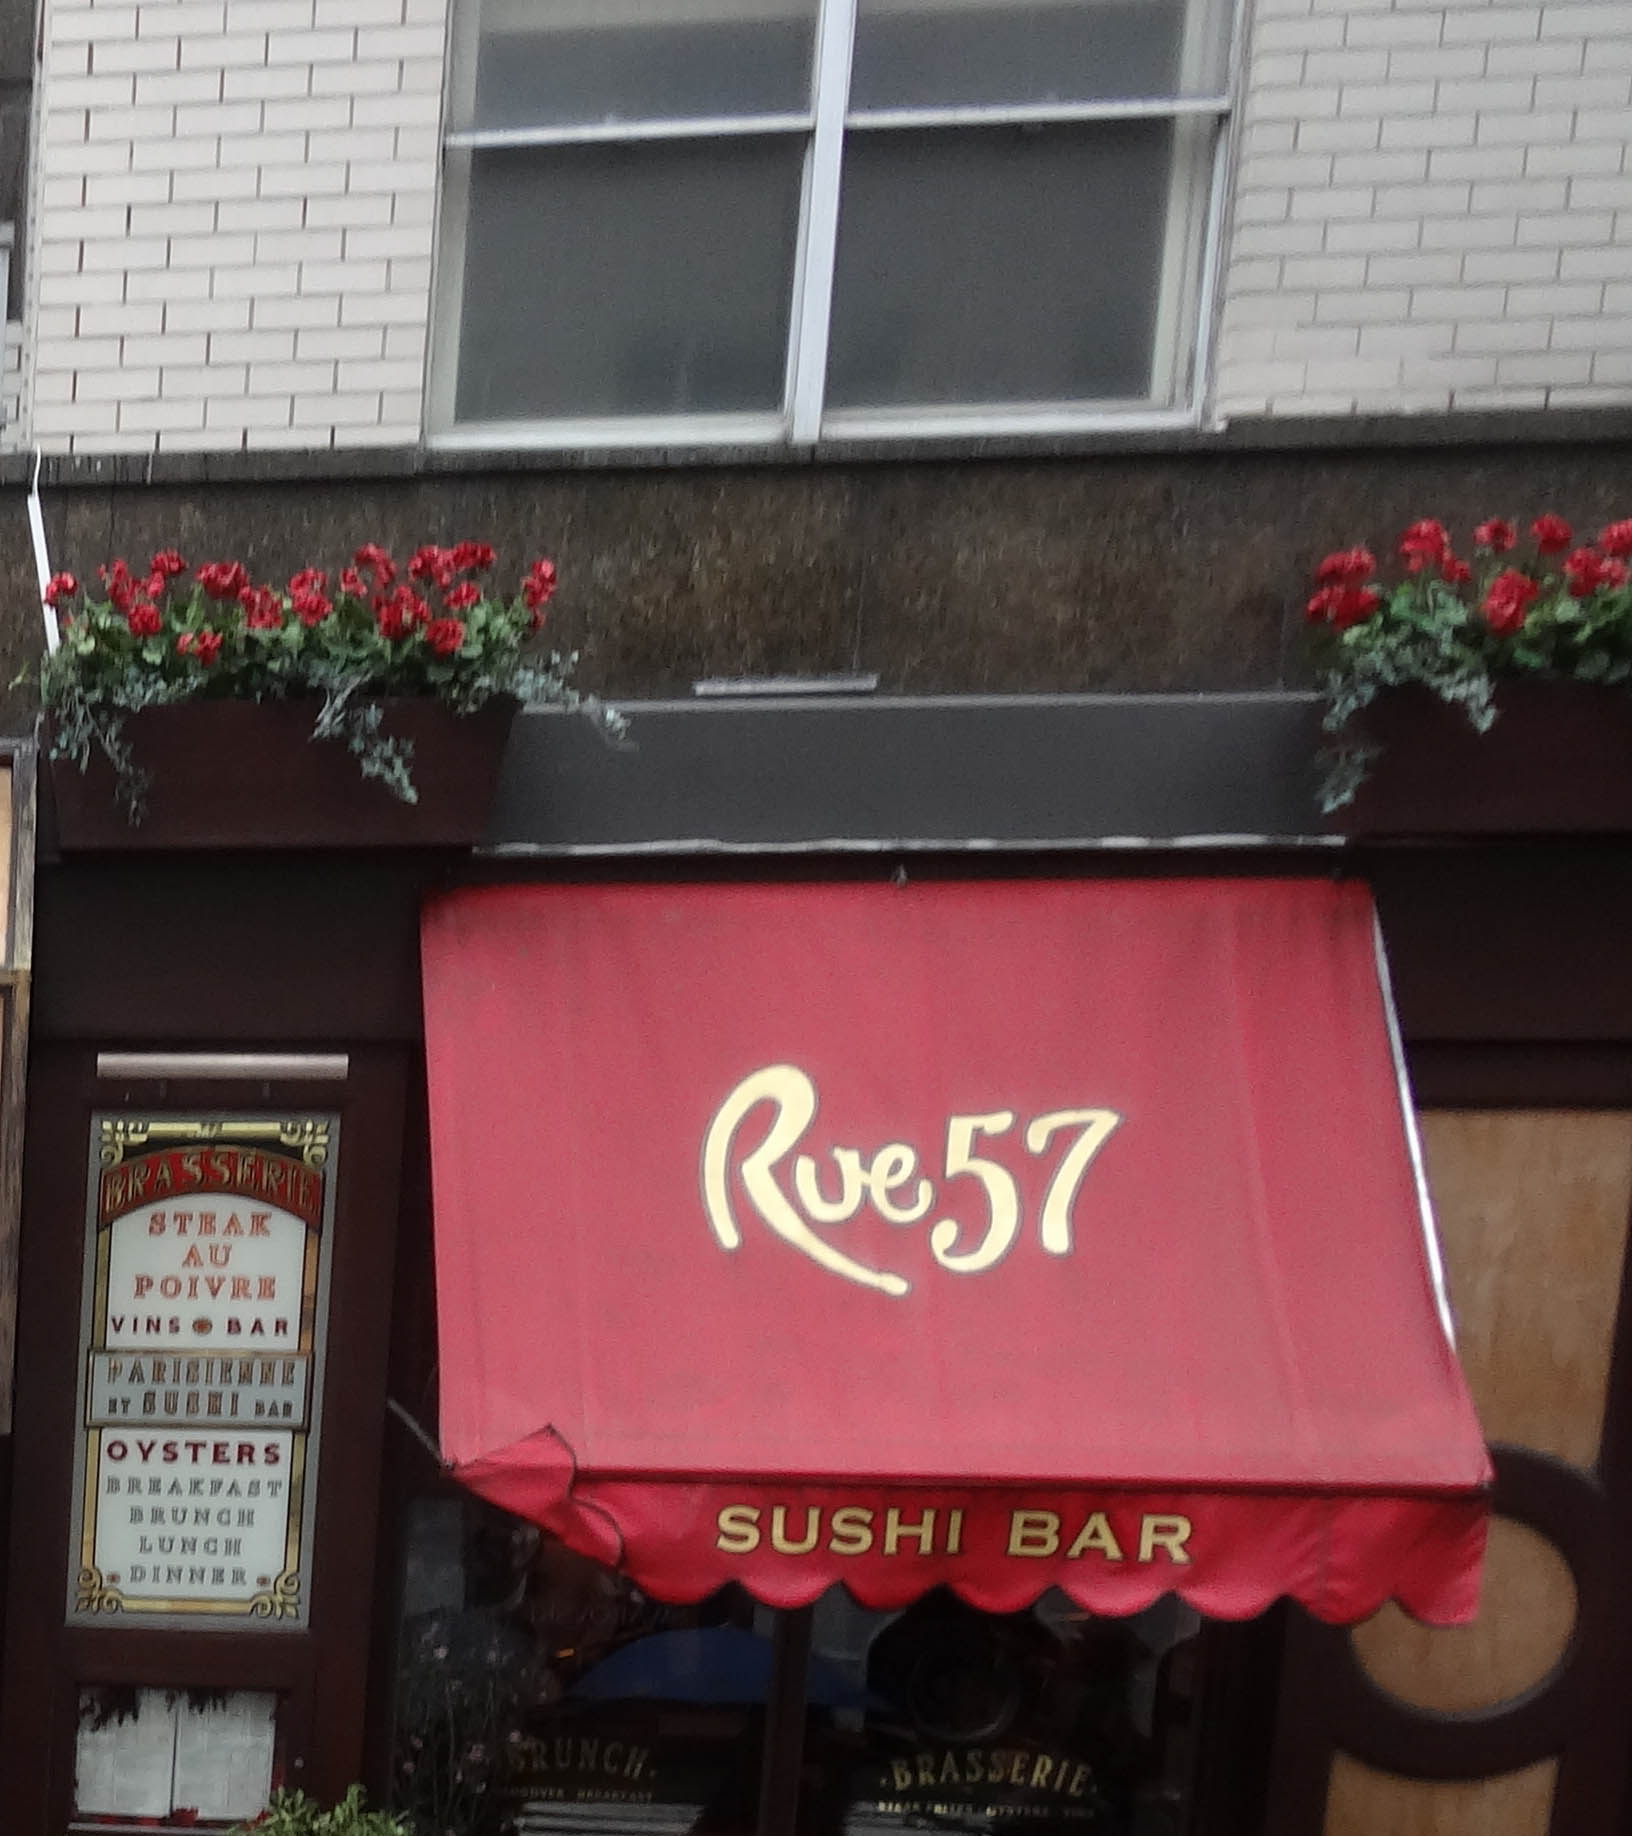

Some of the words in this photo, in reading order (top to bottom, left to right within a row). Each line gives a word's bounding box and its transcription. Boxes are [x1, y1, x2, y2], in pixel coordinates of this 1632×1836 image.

[104, 1151, 320, 1214] BRASSERIE
[704, 1064, 933, 1296] Rue
[929, 1108, 1125, 1273] 57
[148, 1211, 272, 1237] STEAK
[182, 1243, 233, 1268] AU
[133, 1274, 276, 1301] POIVRE
[111, 1316, 181, 1335] VINS
[227, 1317, 288, 1336] BAR
[107, 1357, 296, 1387] PARISIENNE
[142, 1390, 240, 1417] SUSHI
[106, 1440, 281, 1465] OYSTERS
[106, 1475, 283, 1497] BREAKFAST
[128, 1506, 255, 1527] BRUNCH
[139, 1535, 242, 1557] LUNCH
[715, 1503, 965, 1557] SUSHI
[1006, 1509, 1193, 1566] BAR
[129, 1565, 247, 1586] DINNER
[891, 1750, 1091, 1797] BRASSERIE
